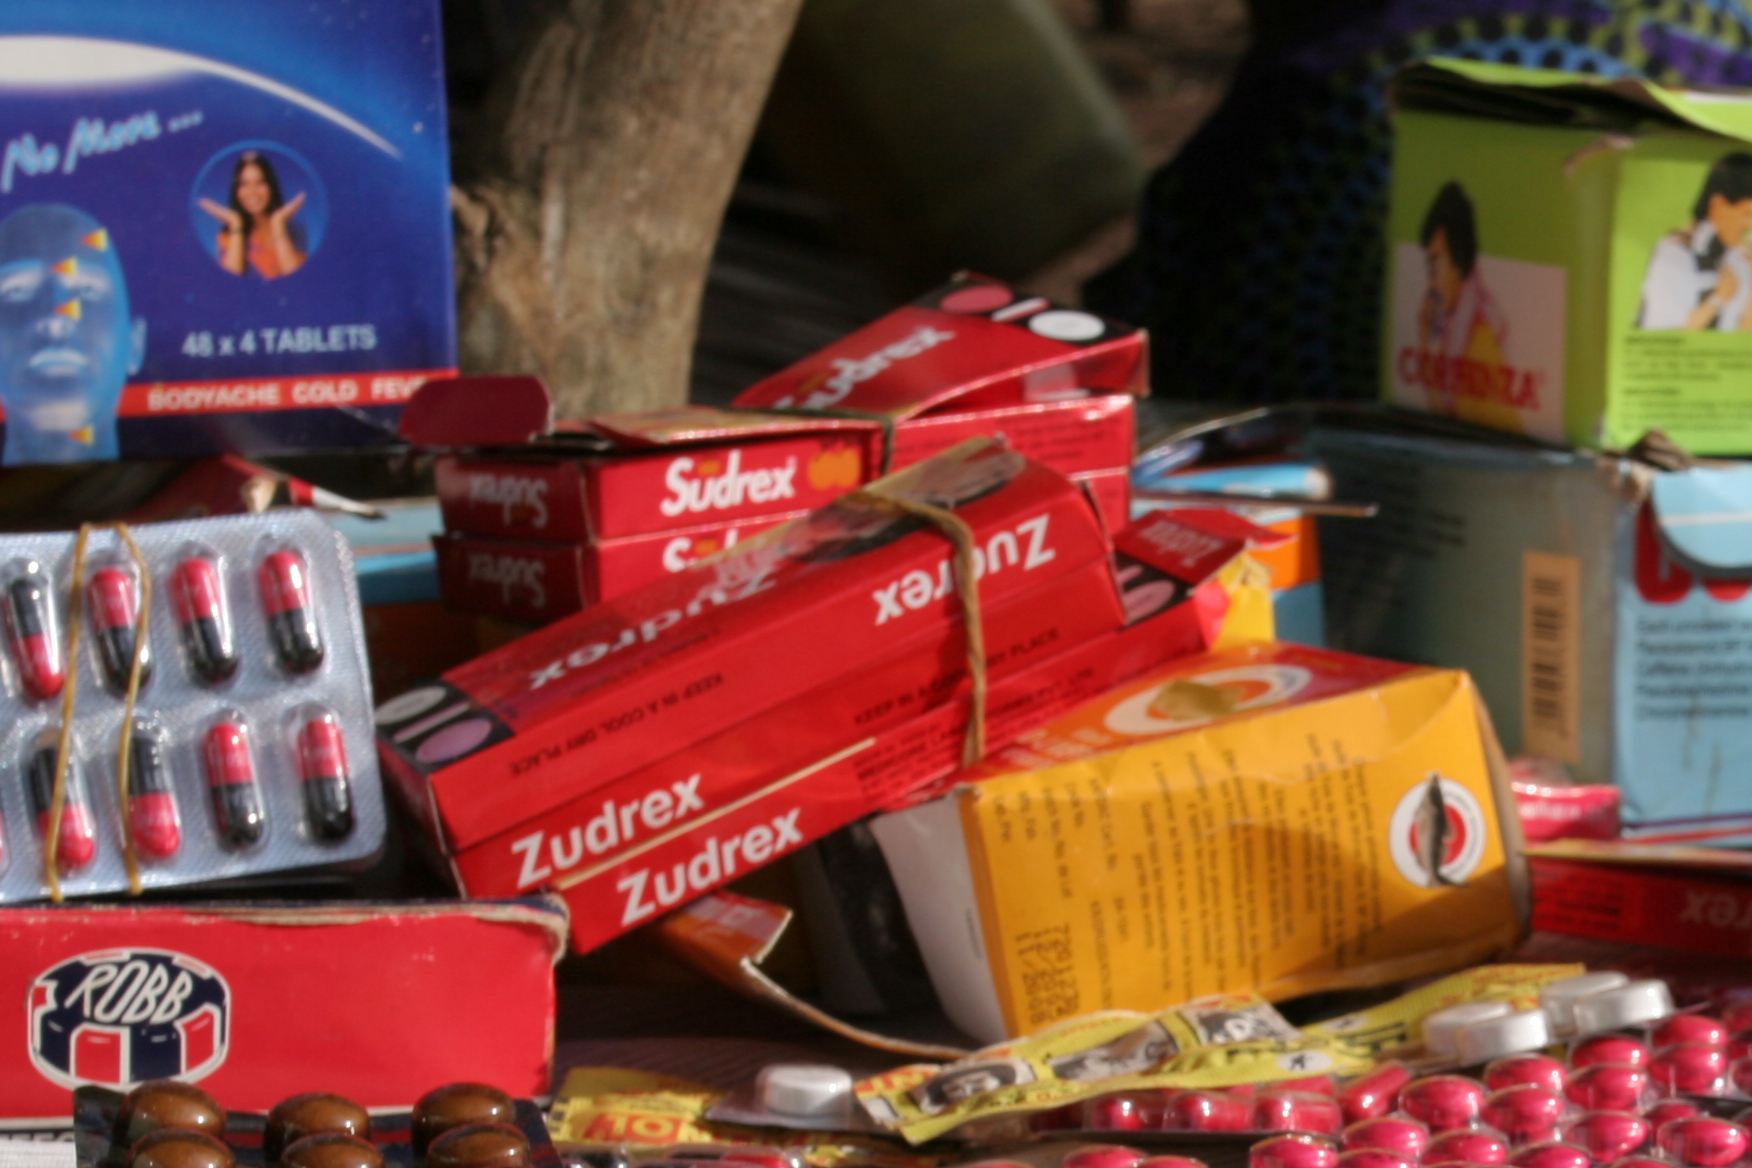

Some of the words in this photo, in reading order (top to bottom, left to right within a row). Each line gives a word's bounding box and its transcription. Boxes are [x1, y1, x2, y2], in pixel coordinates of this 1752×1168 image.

[240, 330, 257, 354] 4
[263, 324, 377, 353] TABLETS
[148, 382, 281, 411] BODYACHE
[292, 378, 357, 404] COLD
[1397, 345, 1543, 414] CORHINZA
[659, 448, 798, 518] Sudrex
[507, 742, 563, 778] PLACE
[511, 773, 704, 890] Zudrex
[616, 808, 802, 928] Zudrex
[63, 957, 195, 1025] ROBB
